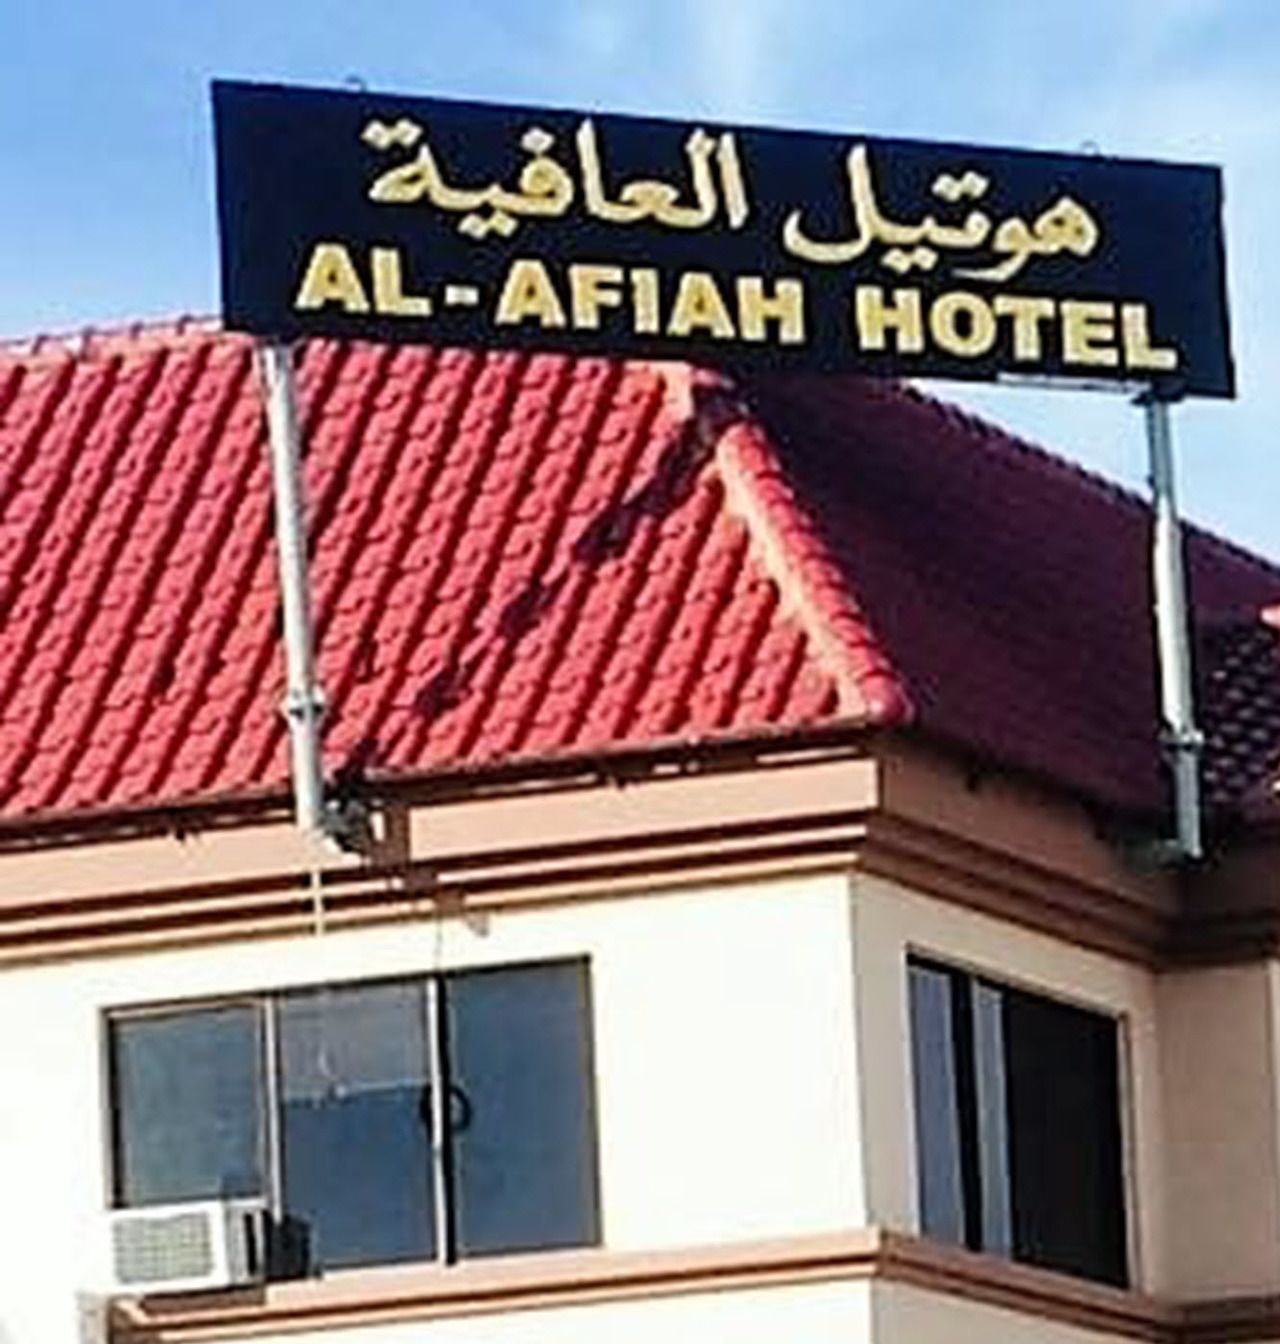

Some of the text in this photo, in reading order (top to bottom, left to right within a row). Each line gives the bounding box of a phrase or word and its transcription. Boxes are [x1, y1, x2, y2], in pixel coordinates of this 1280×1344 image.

[361, 118, 1098, 282] هوتيل العافية
[855, 284, 1179, 370] HOTEL
